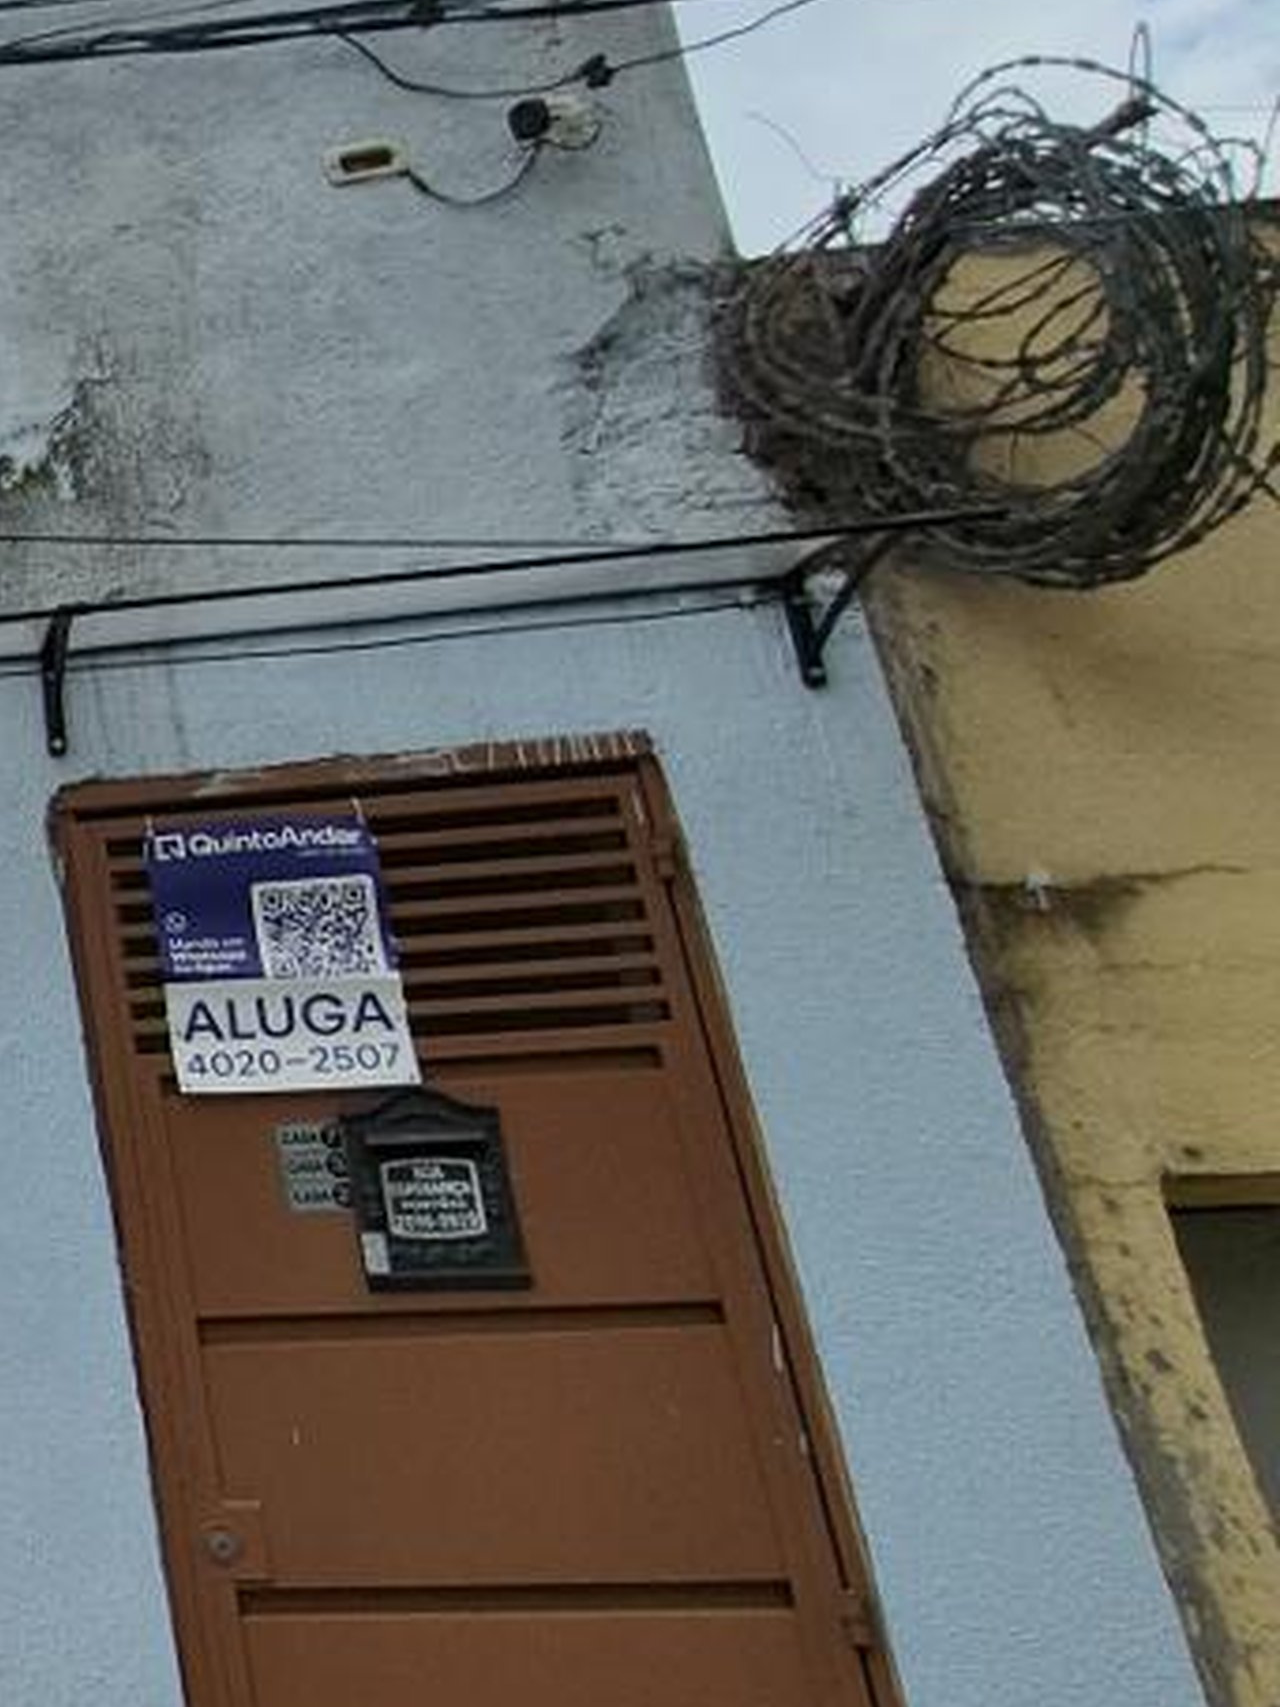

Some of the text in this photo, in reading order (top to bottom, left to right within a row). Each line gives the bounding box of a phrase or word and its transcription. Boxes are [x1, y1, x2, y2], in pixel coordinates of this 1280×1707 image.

[188, 825, 362, 856] QuintoAndar
[183, 991, 395, 1042] ALUGA
[186, 1043, 401, 1078] 4020-2507
